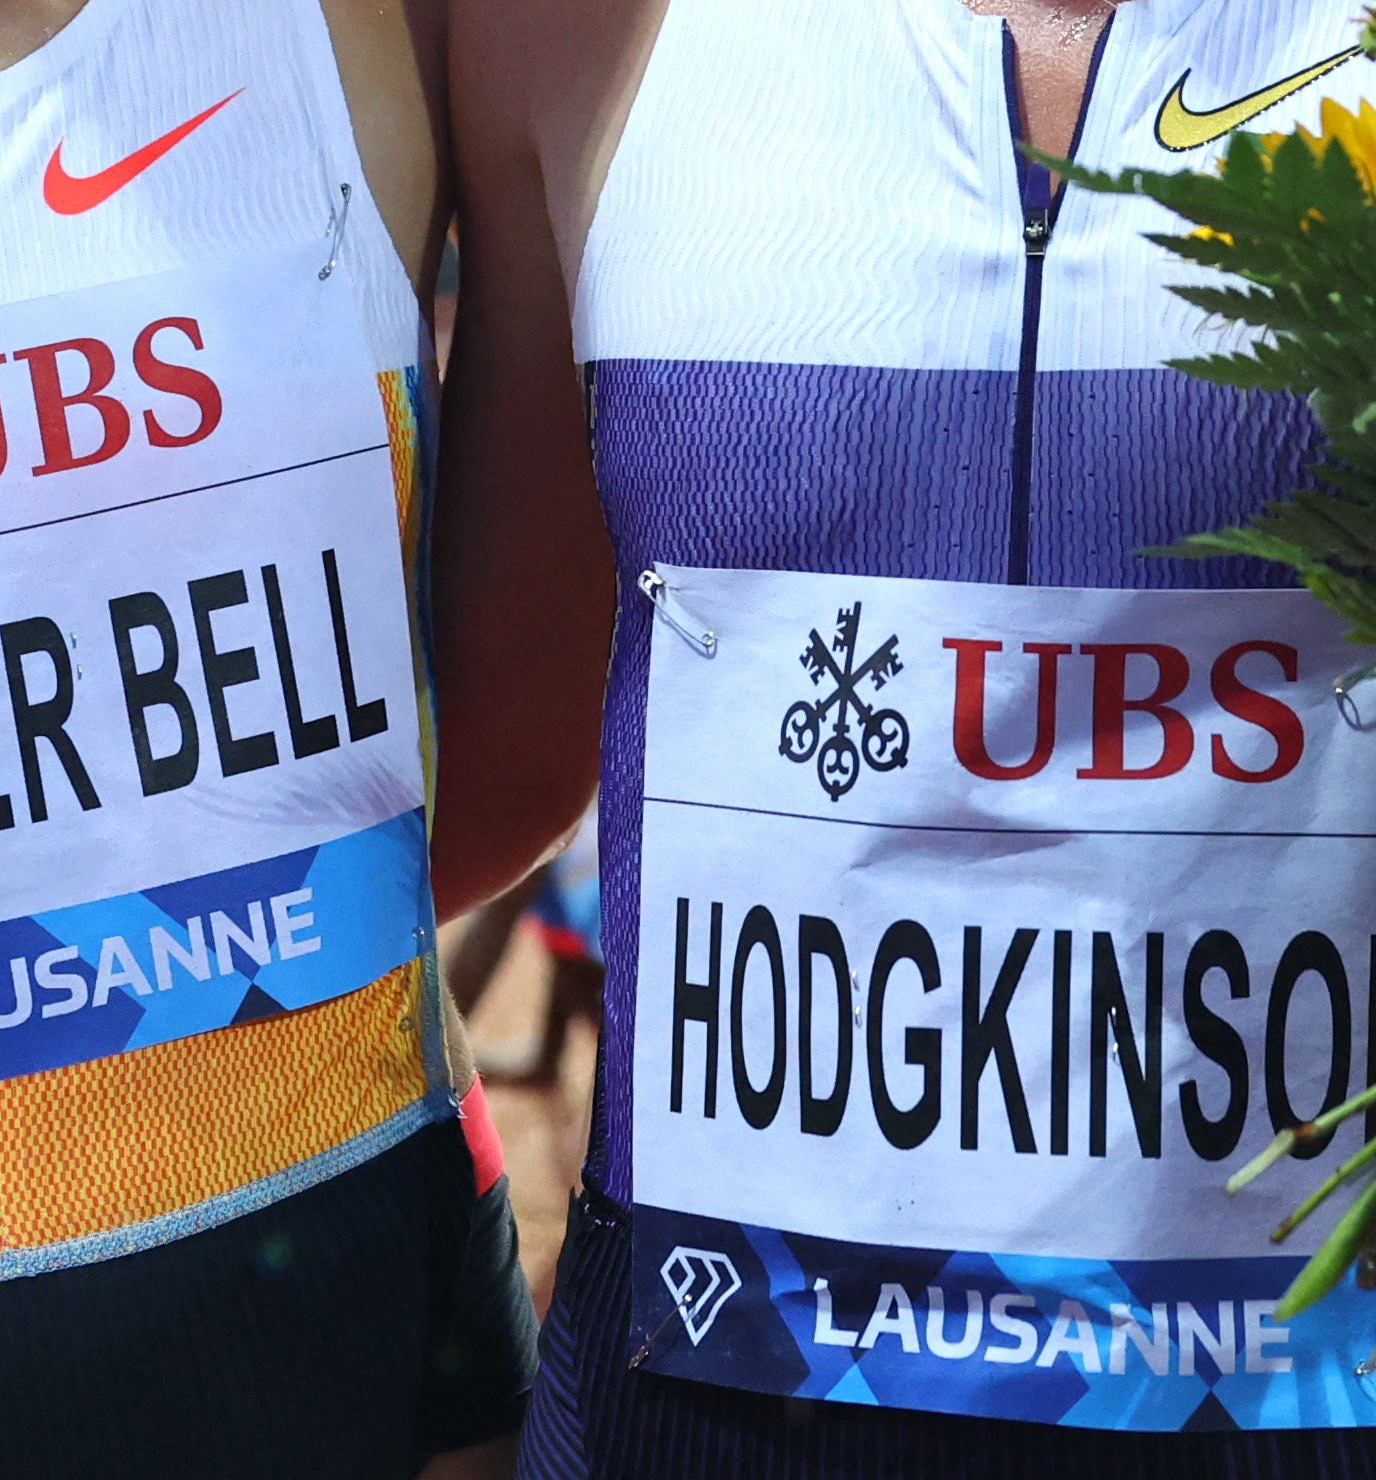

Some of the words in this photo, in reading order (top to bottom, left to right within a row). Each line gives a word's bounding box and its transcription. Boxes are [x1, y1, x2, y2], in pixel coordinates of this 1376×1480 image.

[109, 548, 388, 798] BELL
[943, 637, 1305, 783] UBS
[813, 1277, 1293, 1377] LAUSANNE
